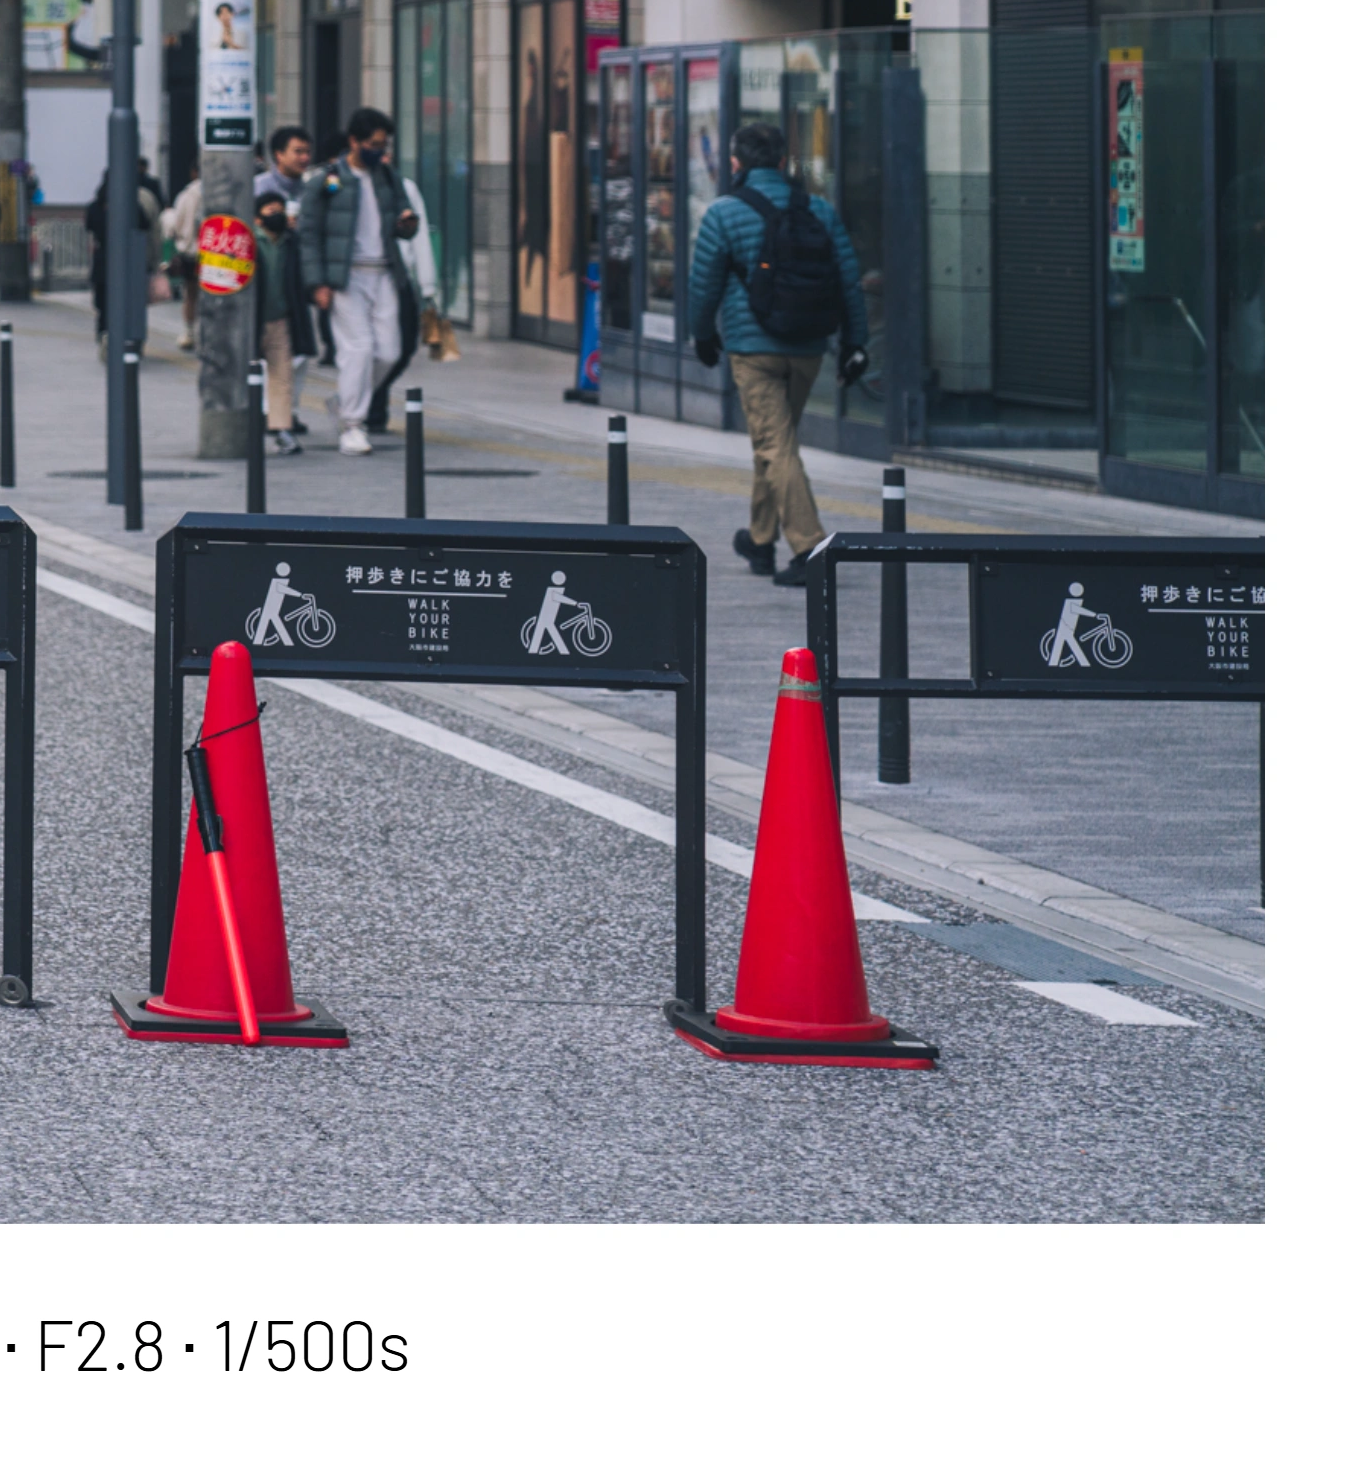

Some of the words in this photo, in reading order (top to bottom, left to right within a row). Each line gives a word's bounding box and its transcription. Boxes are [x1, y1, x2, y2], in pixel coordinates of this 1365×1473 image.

[346, 566, 512, 588] 押歩きにご協力を
[1141, 585, 1265, 604] 押歩きにご協
[408, 598, 449, 610] WALK
[409, 613, 449, 625] YOUR
[1205, 616, 1249, 628] WALK
[408, 627, 449, 639] BIKE
[1207, 631, 1249, 643] YOUR
[1207, 646, 1249, 658] BIKE
